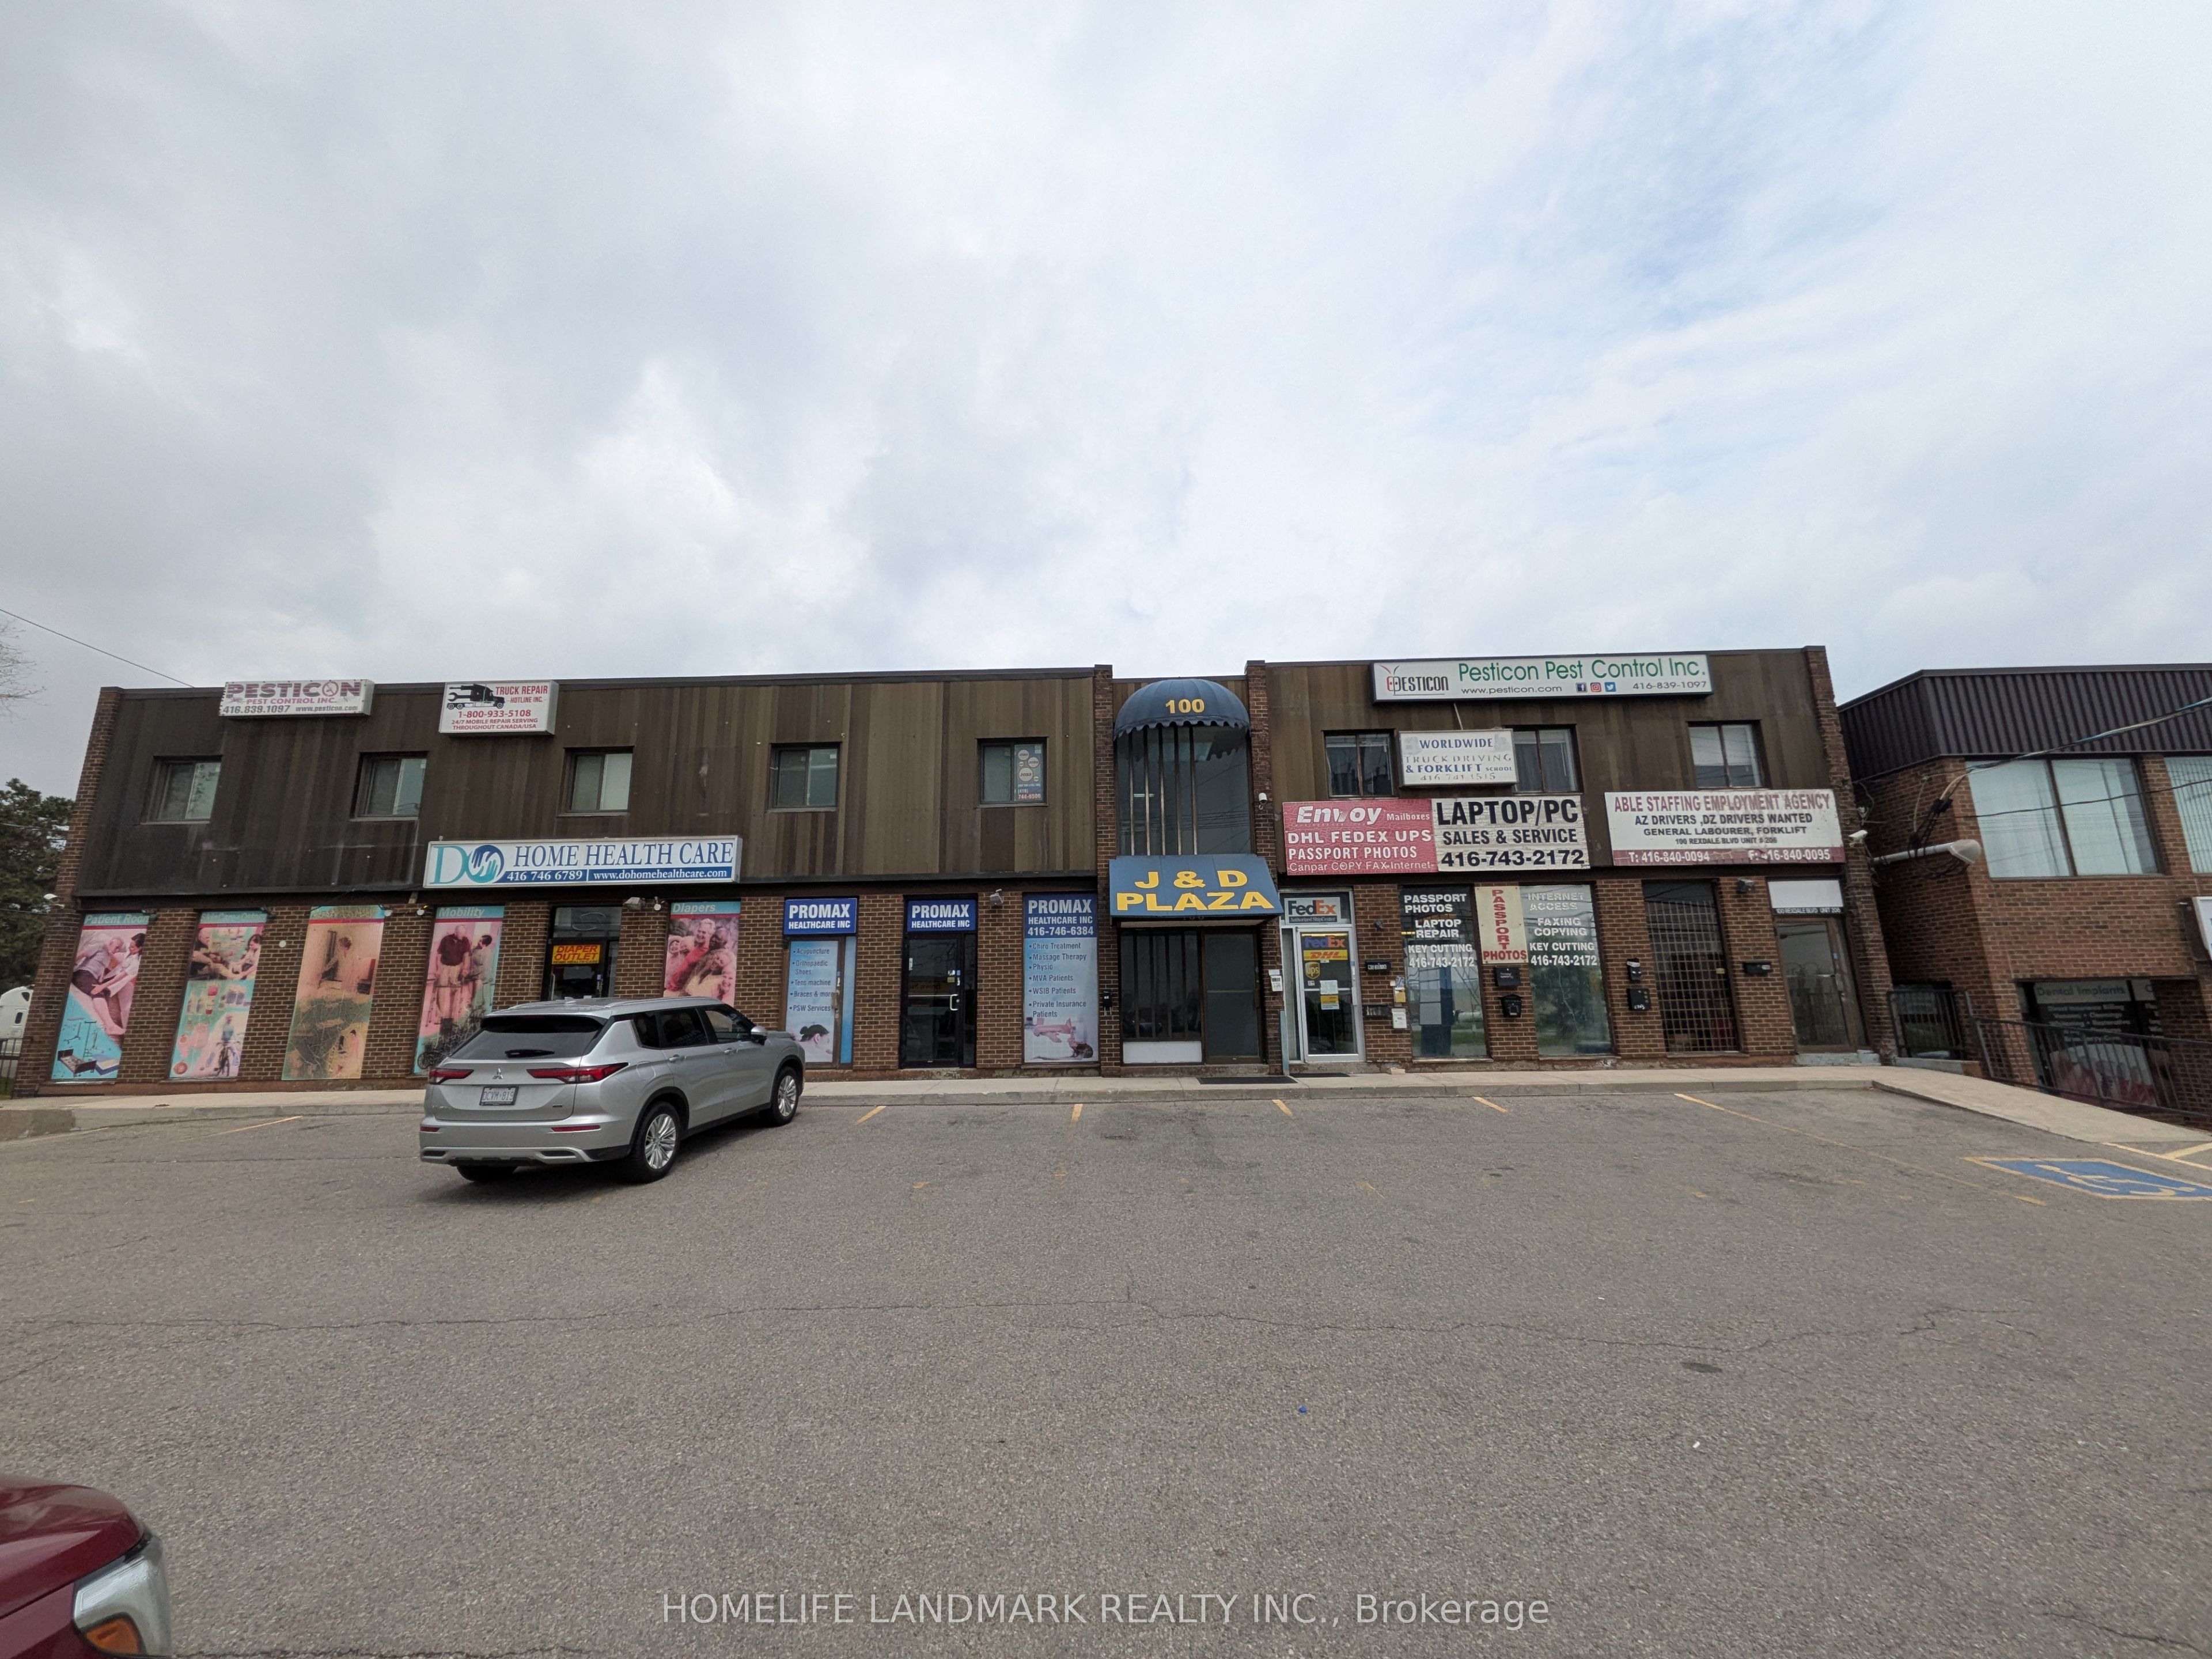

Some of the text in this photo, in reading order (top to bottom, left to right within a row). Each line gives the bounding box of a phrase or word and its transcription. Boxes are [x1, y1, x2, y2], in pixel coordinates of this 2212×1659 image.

[1459, 657, 1705, 681] Pesticon Pest Control Inc.
[495, 685, 548, 695] TRUCK REPAIR
[1461, 681, 1707, 695] www.pesticon.com 416-839-1097
[223, 705, 290, 714] 416.839.1097
[1165, 698, 1205, 714] 100
[458, 710, 531, 718] 1-800-933-5108
[1419, 738, 1493, 748] WORLDWIDE
[1404, 753, 1512, 763] TRUCK DRIVING
[1406, 764, 1414, 773] &
[1418, 763, 1482, 772] FORKLIFT
[1615, 793, 1830, 812] ABLE STAFFING EMPLOYMENT AGENCY
[1297, 806, 1382, 825] Envoy
[1387, 813, 1430, 821] Mailboxes
[1436, 799, 1578, 826] LAPTOP/PC
[1635, 816, 1649, 825] AZ
[1652, 815, 1696, 825] DRIVERS
[1720, 814, 1764, 824] DRIVERS
[1767, 813, 1812, 823] WANTED
[1443, 828, 1578, 845] SALES & SERVICE
[1695, 827, 1753, 835] LABOURER,
[1288, 830, 1431, 844] DHL FEDEX UPS
[514, 842, 734, 867] HOME HEALTH CARE
[1289, 846, 1417, 860] PASSPORT PHOTOS
[1441, 850, 1584, 867] 416-743-2172
[1628, 852, 1639, 863] T:
[1642, 851, 1710, 862] 416-840-0094
[1290, 862, 1327, 873] Canpar
[1331, 862, 1362, 870] COPY
[1391, 861, 1431, 869] Internet
[506, 868, 728, 882] 416 746 6789 www.dohomehealthcare.com
[1134, 870, 1248, 888] J & D
[1116, 891, 1274, 911] PLAZA
[1404, 893, 1467, 903] PASSPORT
[672, 903, 715, 914] Diapers
[789, 904, 851, 919] PROMAX
[912, 904, 969, 918] PROMAX
[1028, 899, 1092, 914] PROMAX
[1288, 900, 1336, 915] FedEx
[1405, 904, 1453, 913] PHOTOS
[1529, 902, 1578, 911] ACCESS
[438, 907, 485, 918] Mobility
[85, 915, 121, 924] Patient
[789, 920, 851, 929] HEALTHCARE INC
[911, 920, 956, 928] HEALTHCARE
[1028, 916, 1093, 925] HEALTHCARE INC
[1415, 919, 1461, 928] LAPTOP
[1491, 889, 1510, 949] PASSPORT
[1537, 917, 1581, 926] FAXING
[1028, 926, 1093, 936] 416-746-6384
[1416, 929, 1459, 938] REPAIR
[1534, 927, 1588, 936] COPYING
[1304, 935, 1345, 948] FedEx
[1529, 942, 1595, 951] KEY CUTTING
[1408, 944, 1472, 953] KEY CUTTING
[1033, 953, 1086, 961] Massage Therapy
[1483, 950, 1527, 960] PHOTOS
[1531, 955, 1598, 966] 416-743-2172
[1033, 963, 1053, 971] Physio
[1409, 956, 1475, 968] 416-743-2172
[1306, 966, 1319, 977] ups
[2036, 984, 2125, 997] Dental Implants
